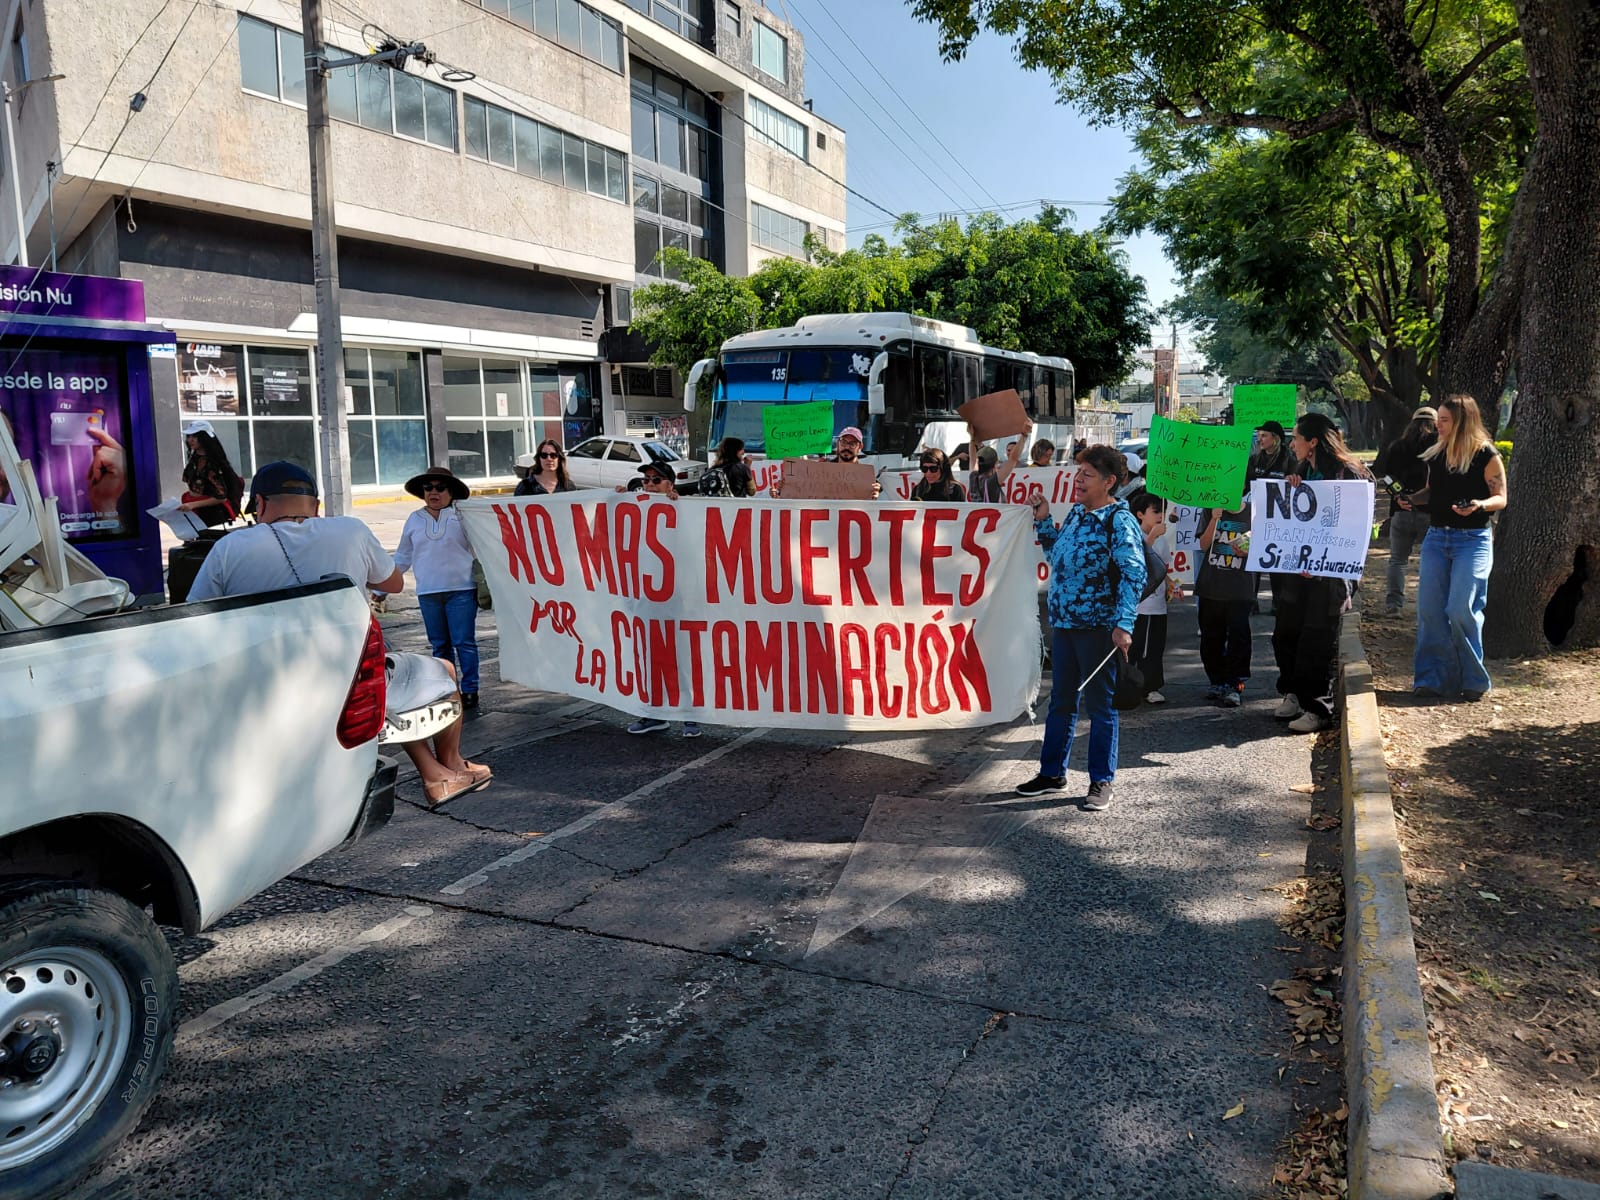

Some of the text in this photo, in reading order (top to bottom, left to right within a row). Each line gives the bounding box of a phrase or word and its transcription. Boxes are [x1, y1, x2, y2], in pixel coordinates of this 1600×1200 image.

[46, 287, 72, 305] Nu
[47, 372, 65, 390] la
[70, 376, 108, 394] app
[771, 368, 786, 381] 135
[1158, 423, 1175, 443] No
[1184, 460, 1222, 471] TIERRA
[1171, 487, 1193, 502] LOS
[1265, 481, 1318, 522] NO
[490, 503, 565, 587] NO
[570, 493, 677, 603] MÁS
[705, 506, 1001, 607] MUERTES
[529, 595, 992, 720] POR LA CONTAMINACIÓN
[121, 977, 159, 1103] COOPER
